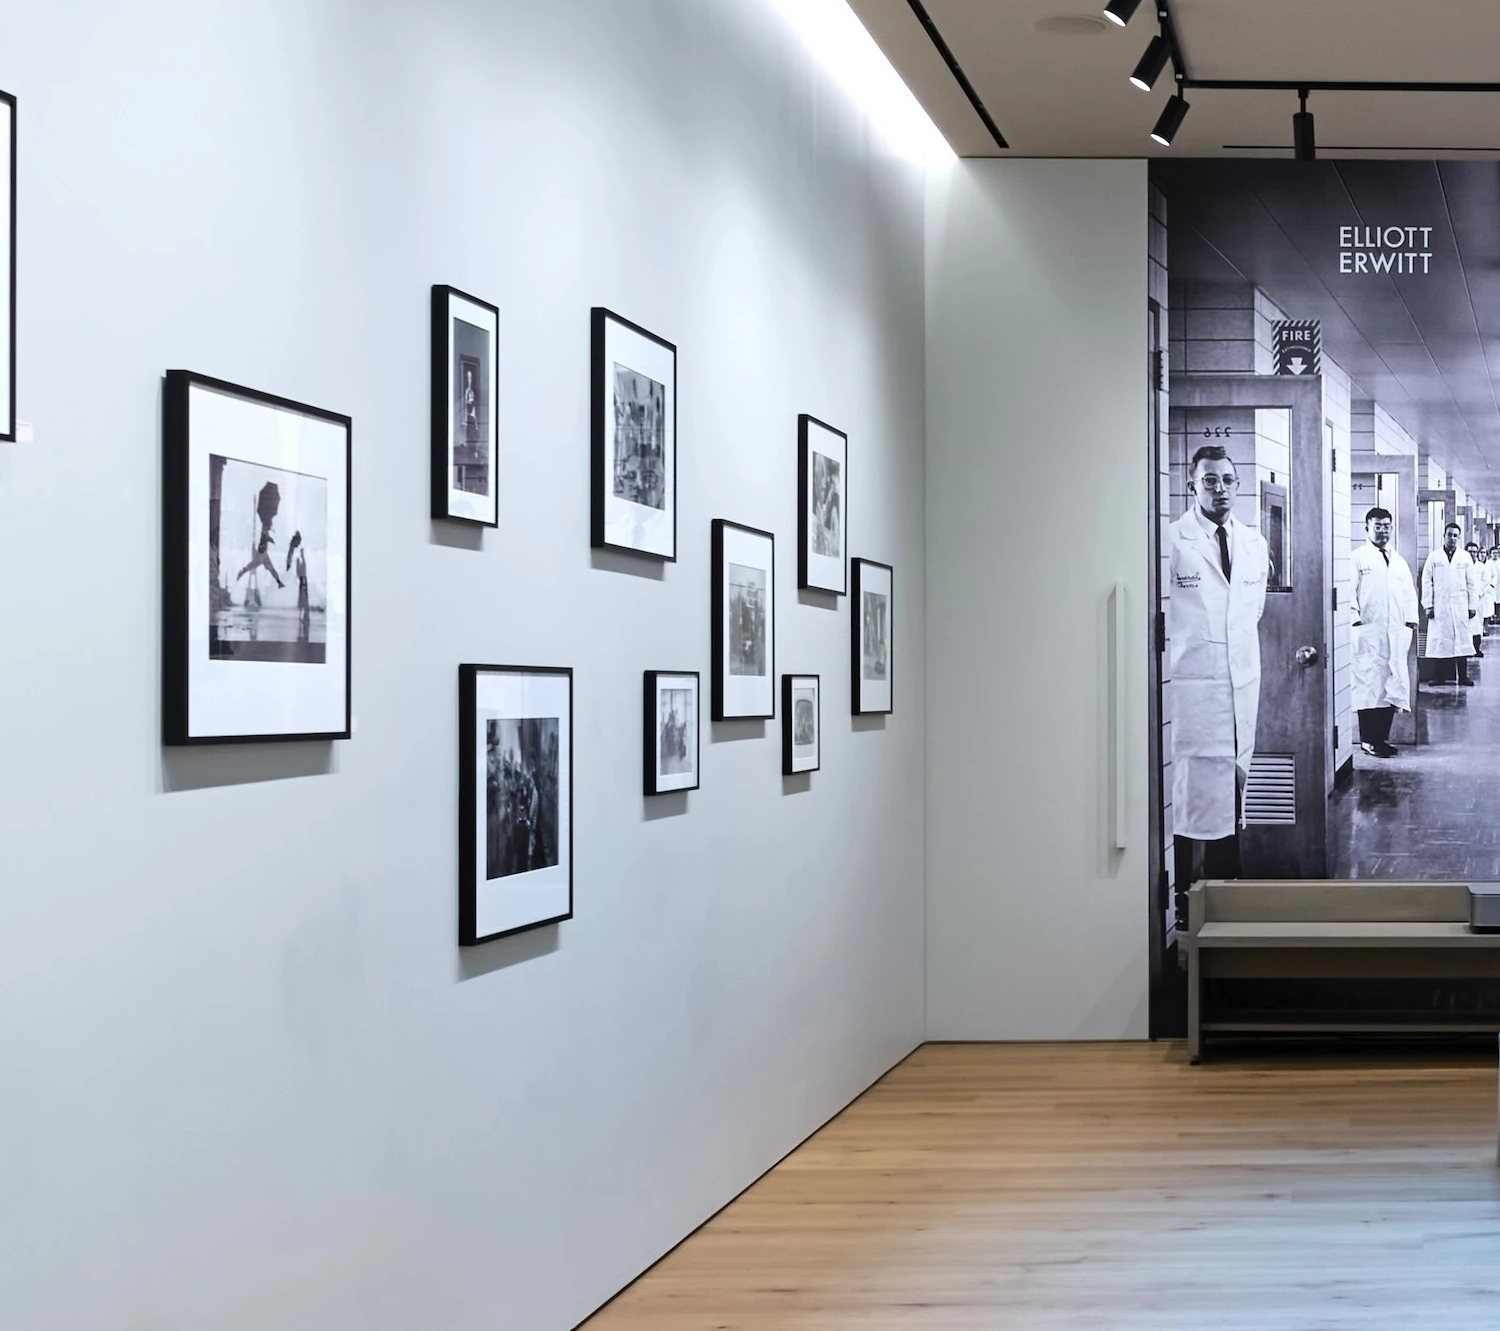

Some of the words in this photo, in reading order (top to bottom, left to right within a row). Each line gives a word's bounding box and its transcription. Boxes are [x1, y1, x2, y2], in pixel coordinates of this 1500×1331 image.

[1339, 226, 1433, 248] ELLIOTT
[1339, 252, 1433, 274] ERWITT
[1282, 330, 1311, 341] FIRE
